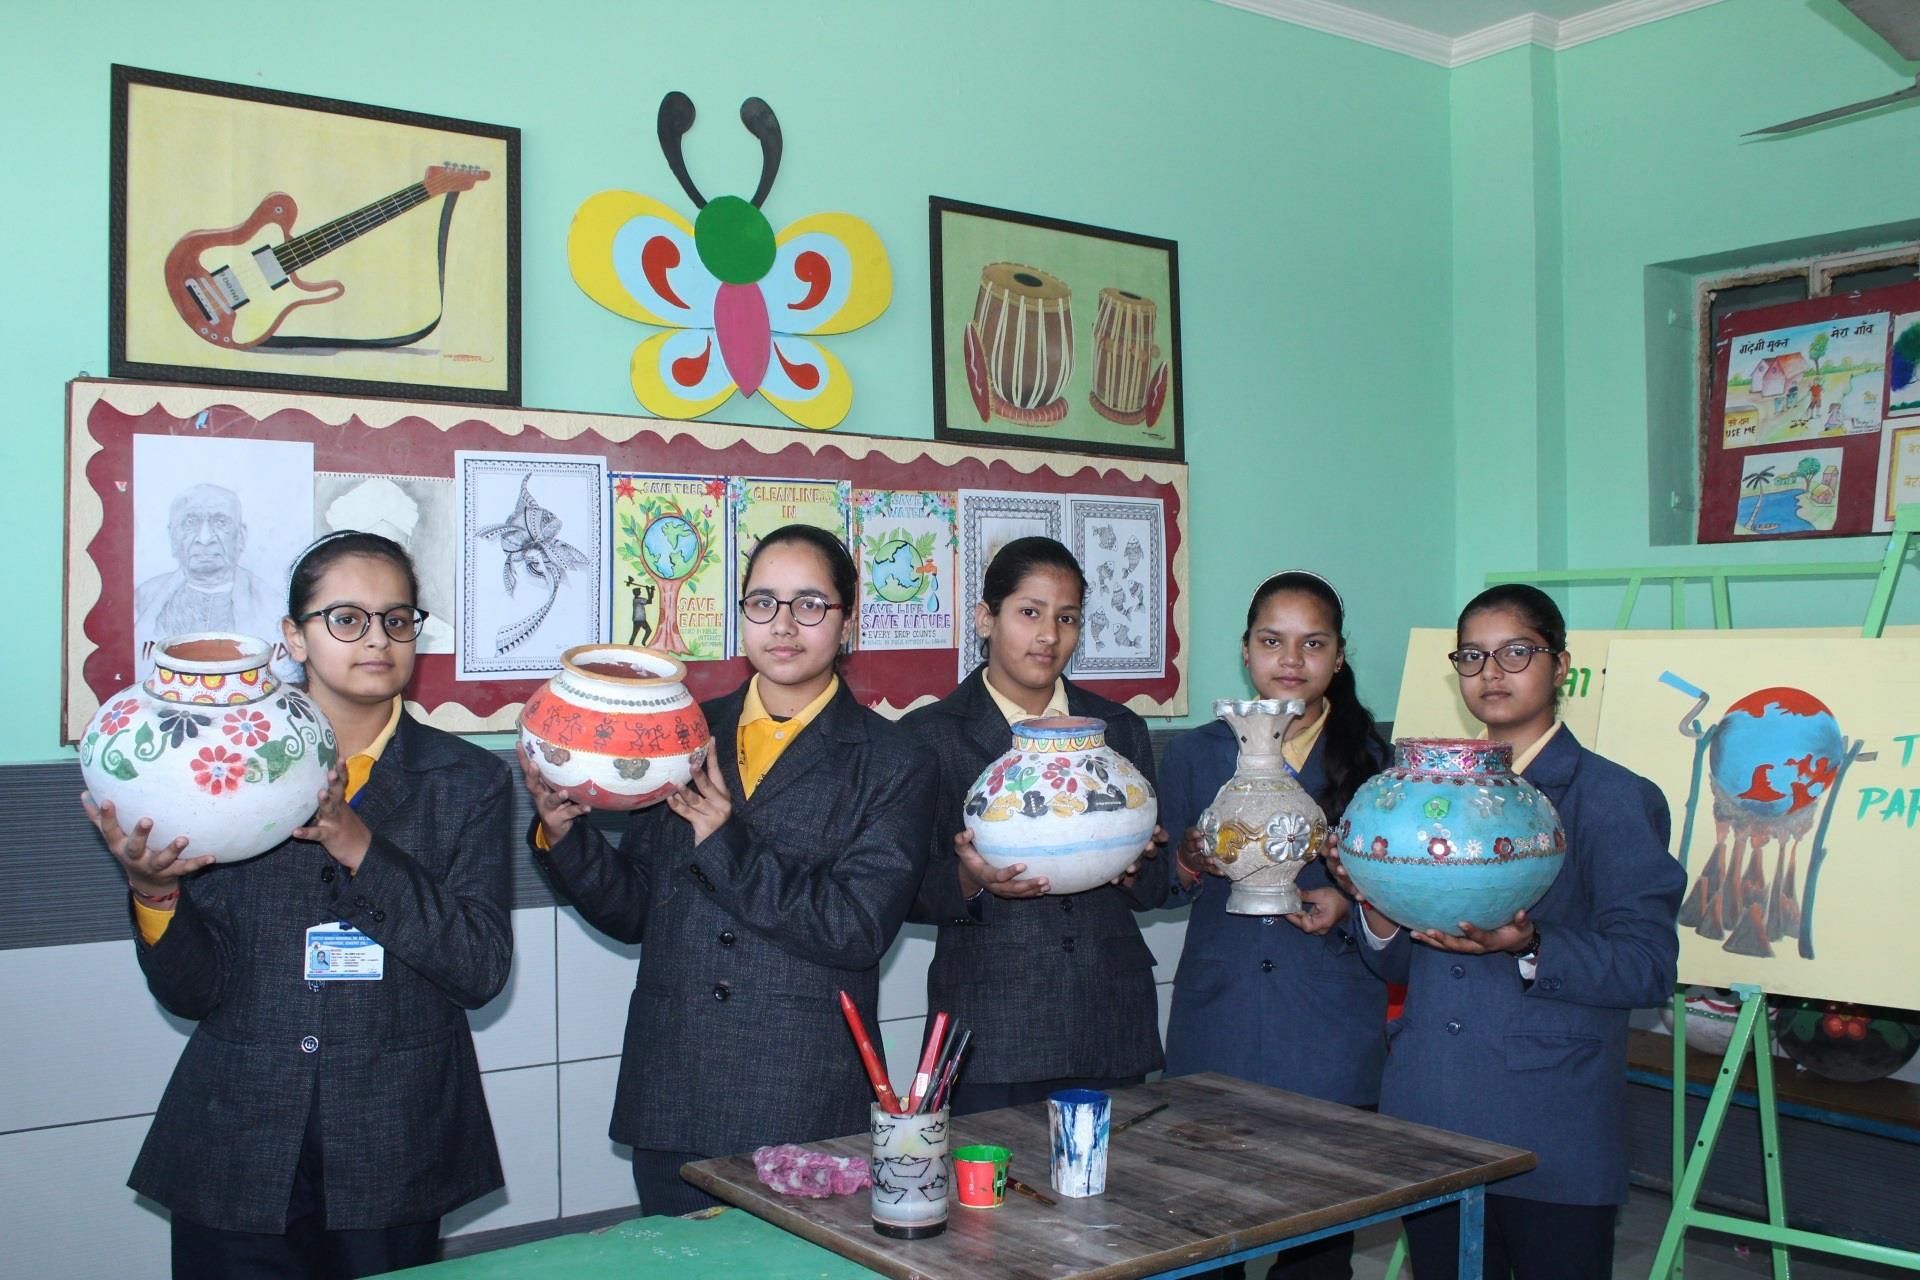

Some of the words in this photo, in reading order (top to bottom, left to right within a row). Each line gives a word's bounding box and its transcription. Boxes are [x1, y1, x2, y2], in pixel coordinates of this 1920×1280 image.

[1726, 428, 1741, 437] USE
[1744, 425, 1757, 435] ME
[643, 482, 671, 494] SAVE
[674, 483, 704, 495] TREE
[892, 494, 922, 506] SAVE
[782, 505, 797, 519] IN
[887, 506, 926, 518] WATER
[677, 598, 715, 612] SAVE
[862, 603, 894, 615] SAVE
[898, 603, 924, 614] LIFE
[680, 613, 723, 628] EARTH
[861, 614, 899, 629] SAVE
[904, 614, 951, 629] NATURE
[867, 630, 892, 639] EVERY
[895, 630, 911, 639] DROP
[912, 630, 937, 638] COUNTS
